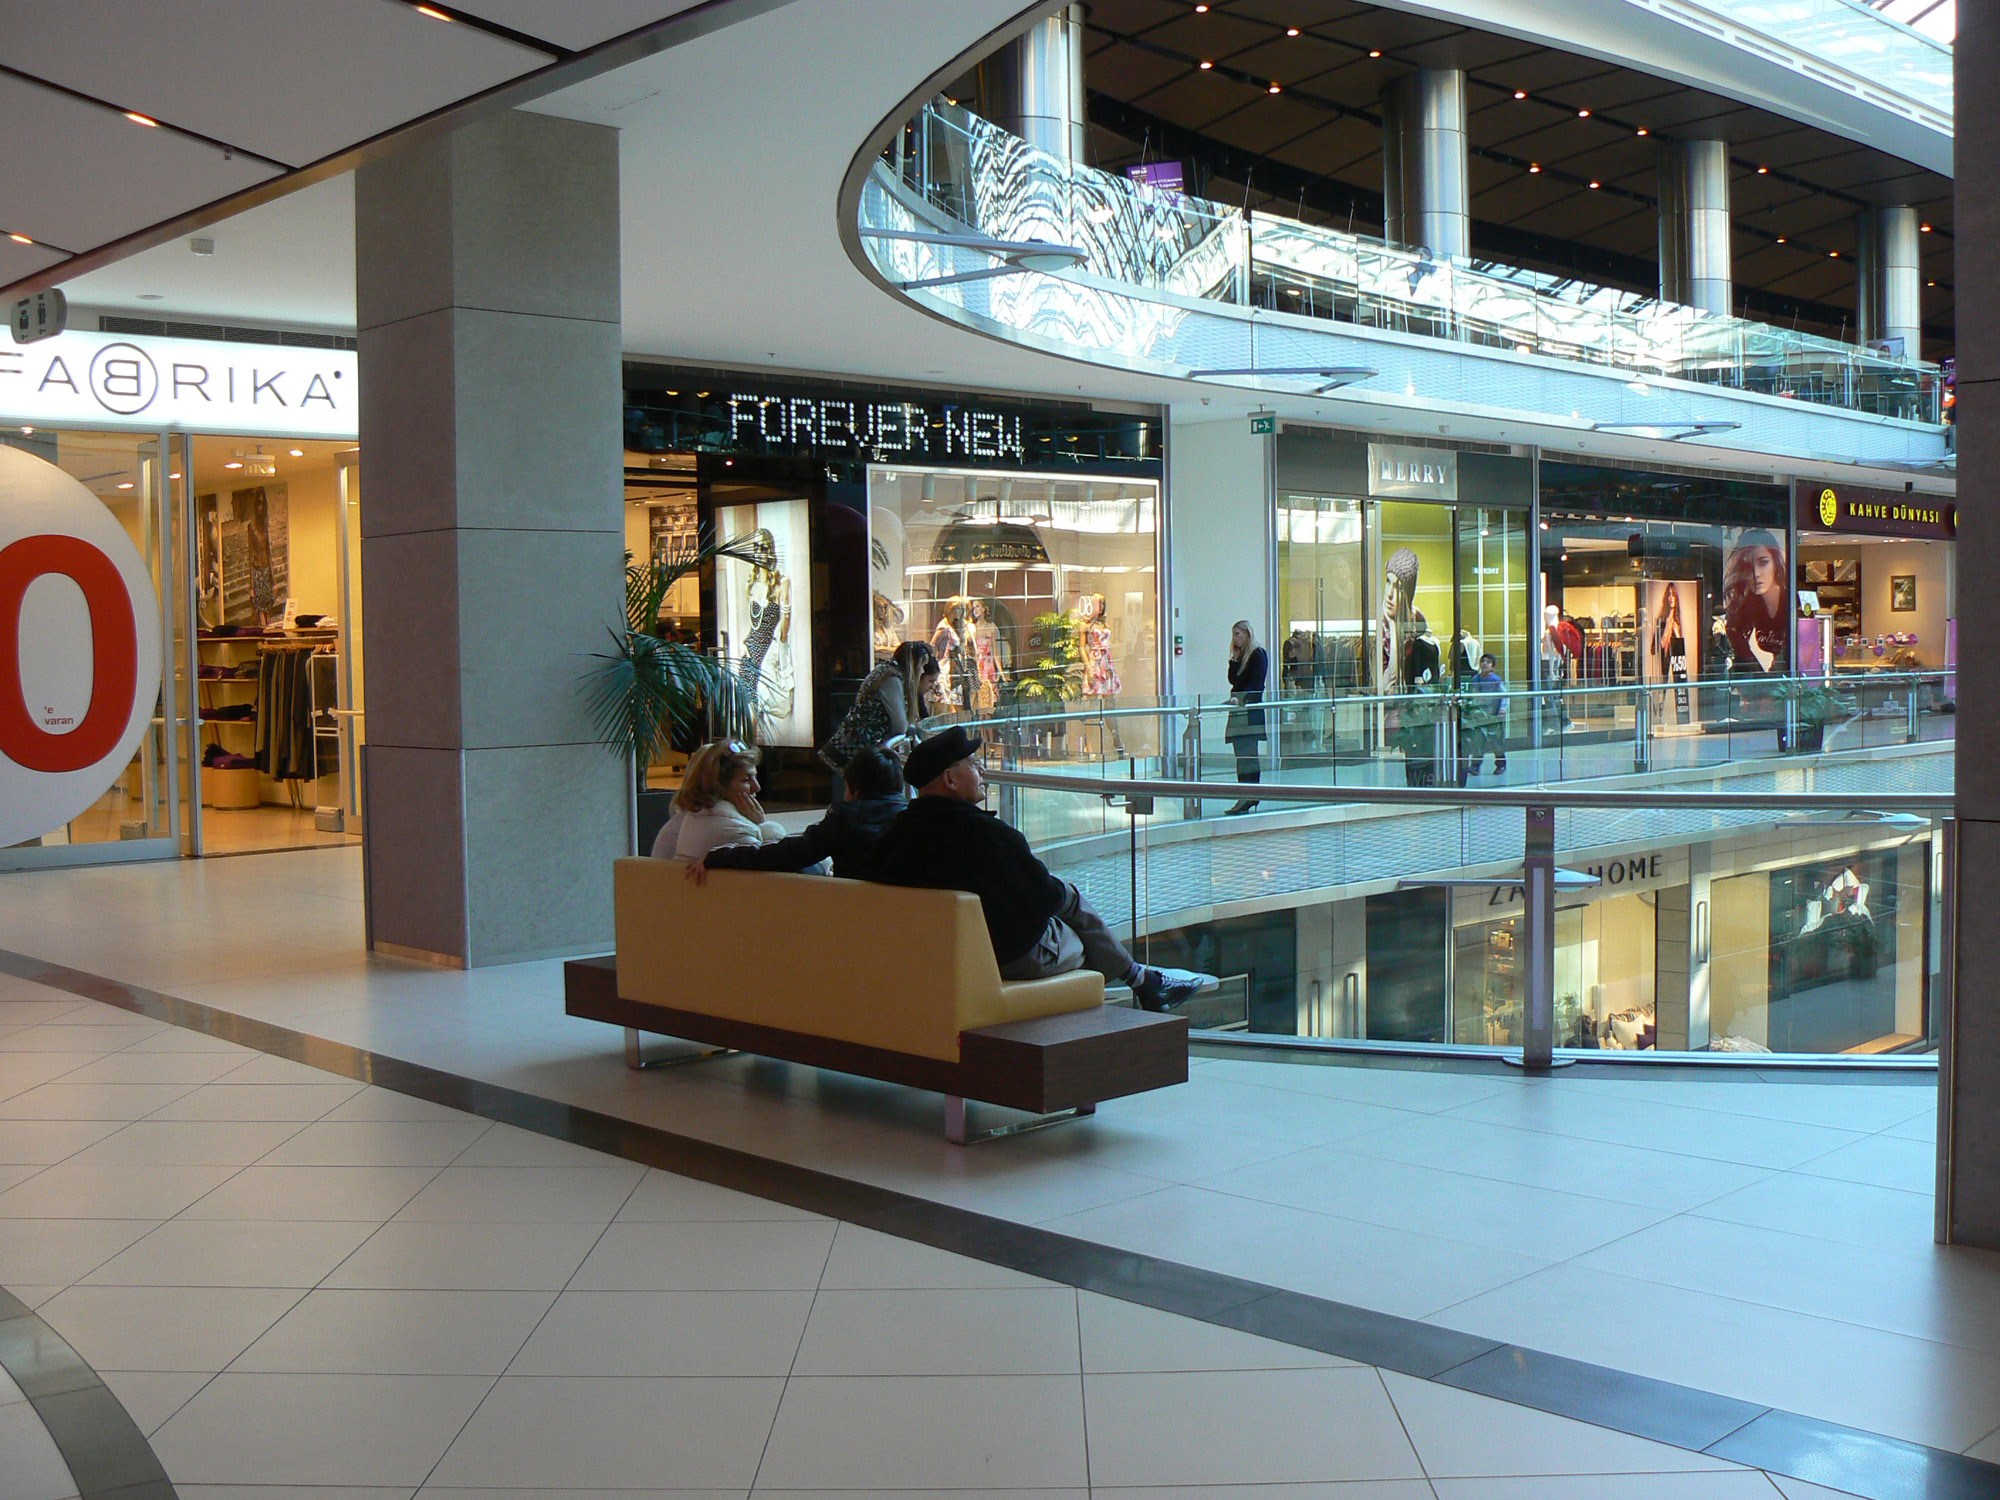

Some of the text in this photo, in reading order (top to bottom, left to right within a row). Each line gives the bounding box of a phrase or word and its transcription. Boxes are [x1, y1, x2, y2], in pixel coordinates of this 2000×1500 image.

[730, 392, 1021, 458] FOREVER NEW
[1849, 502, 1939, 524] KAHVE DÜNYASI
[1670, 655, 1687, 672] %50
[44, 717, 74, 726] varan
